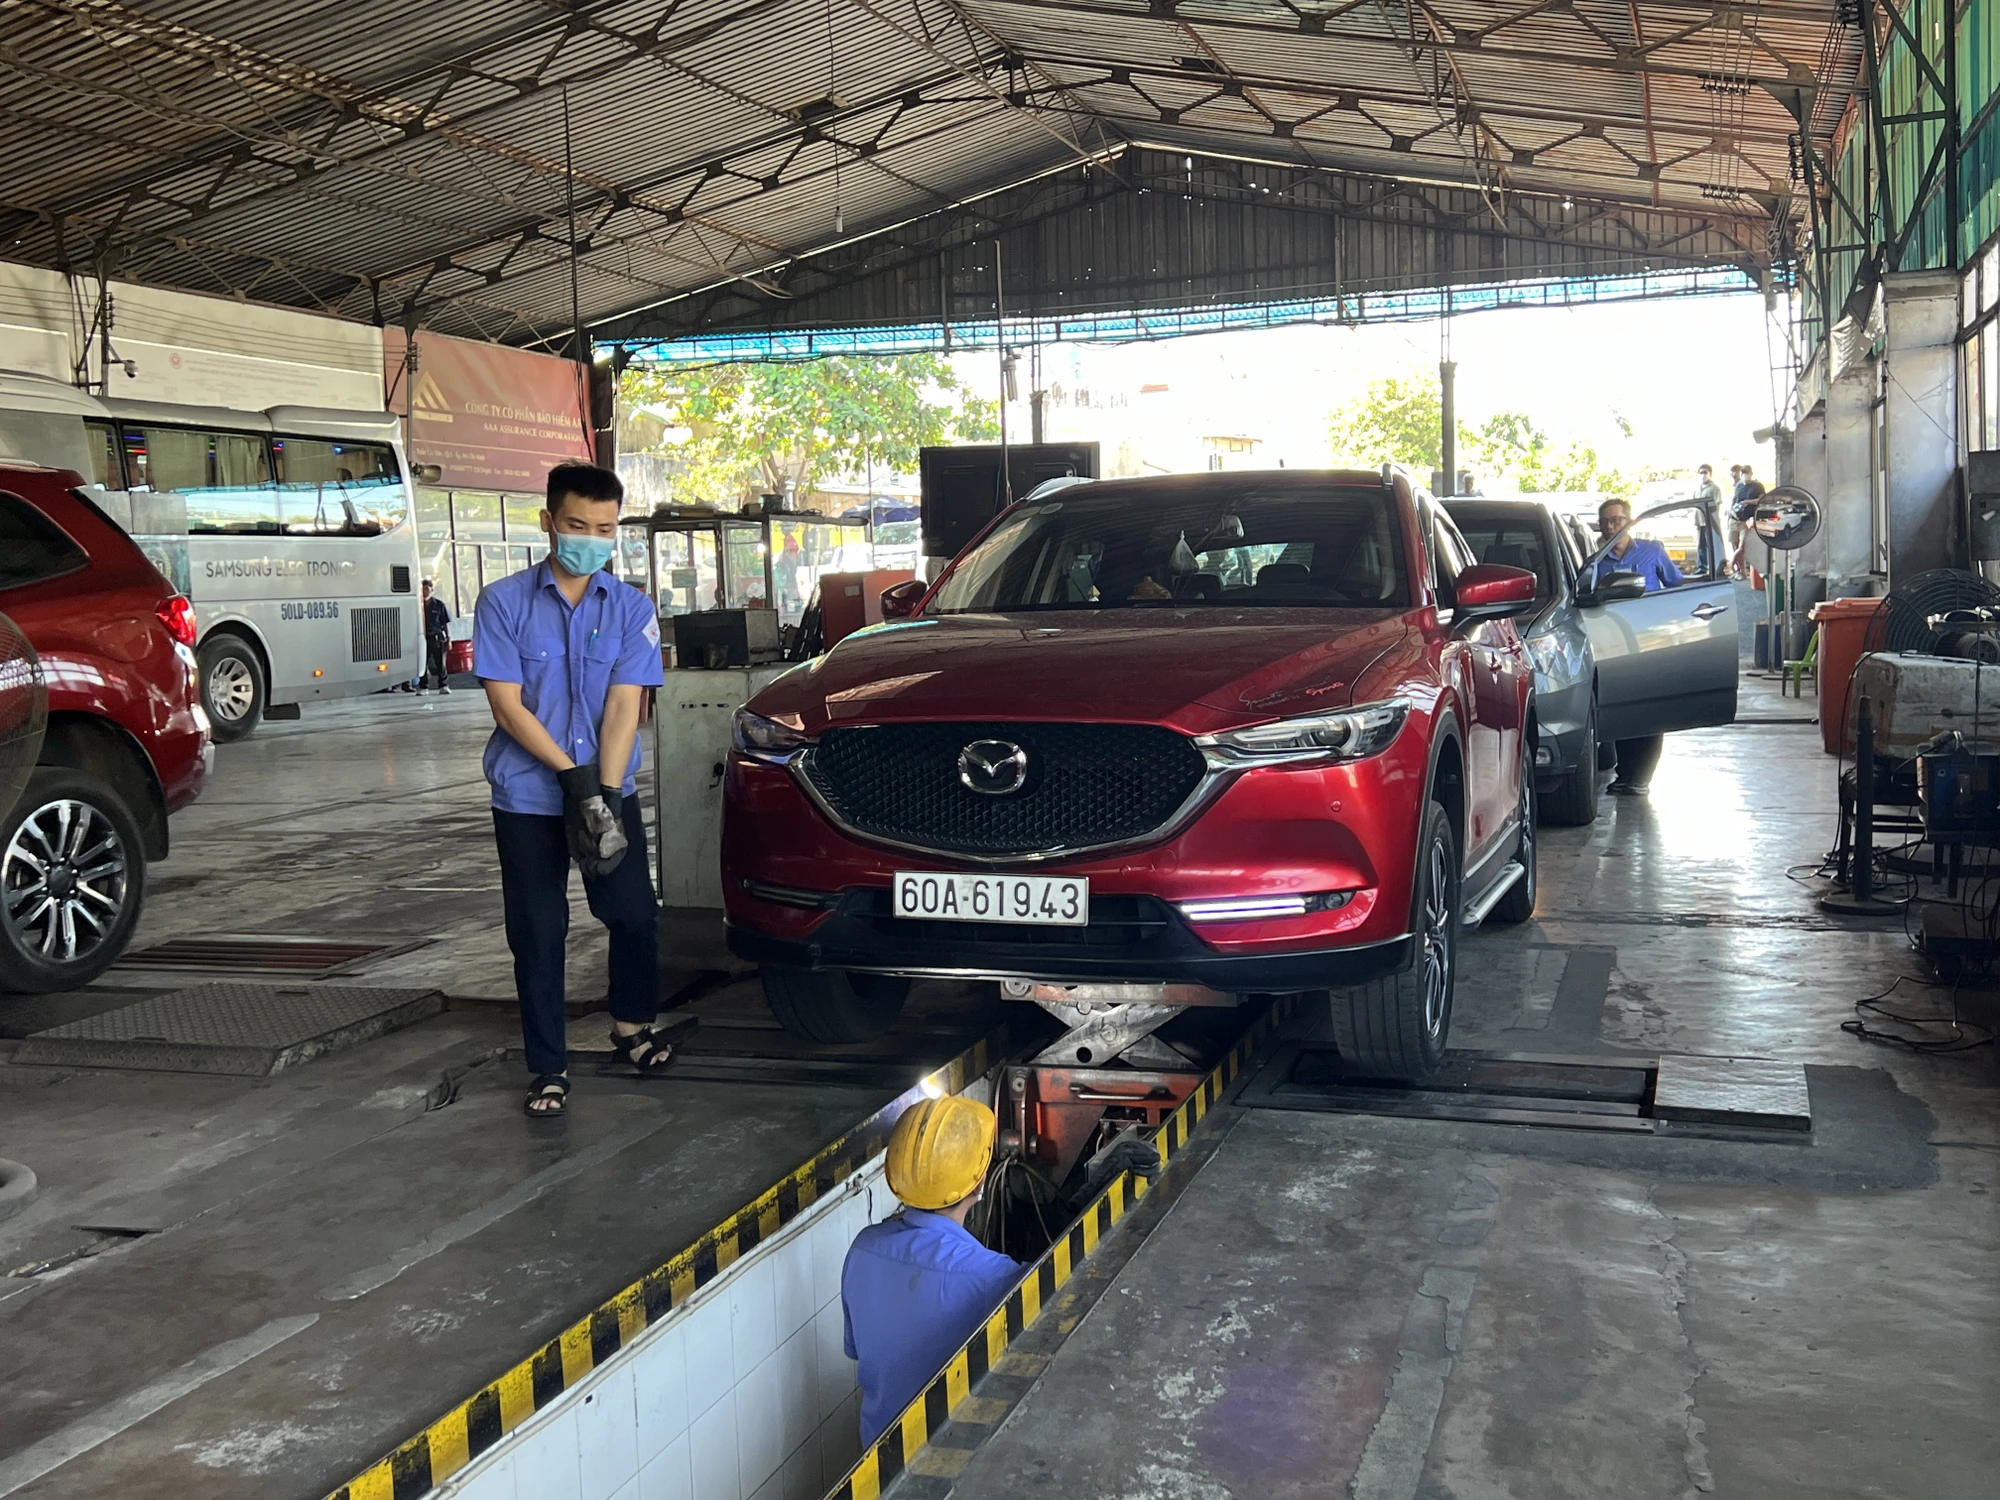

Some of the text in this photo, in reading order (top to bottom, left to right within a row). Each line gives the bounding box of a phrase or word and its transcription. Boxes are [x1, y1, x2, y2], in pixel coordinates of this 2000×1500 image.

[465, 399, 489, 416] CÔNG
[491, 404, 501, 418] TY
[484, 422, 582, 442] AAA ASSURANCE CORPORATION
[206, 560, 358, 578] SAMSUNG ELECTRONICS
[281, 601, 339, 620] 50LD-089.56
[901, 877, 1080, 919] 60A-619.43
